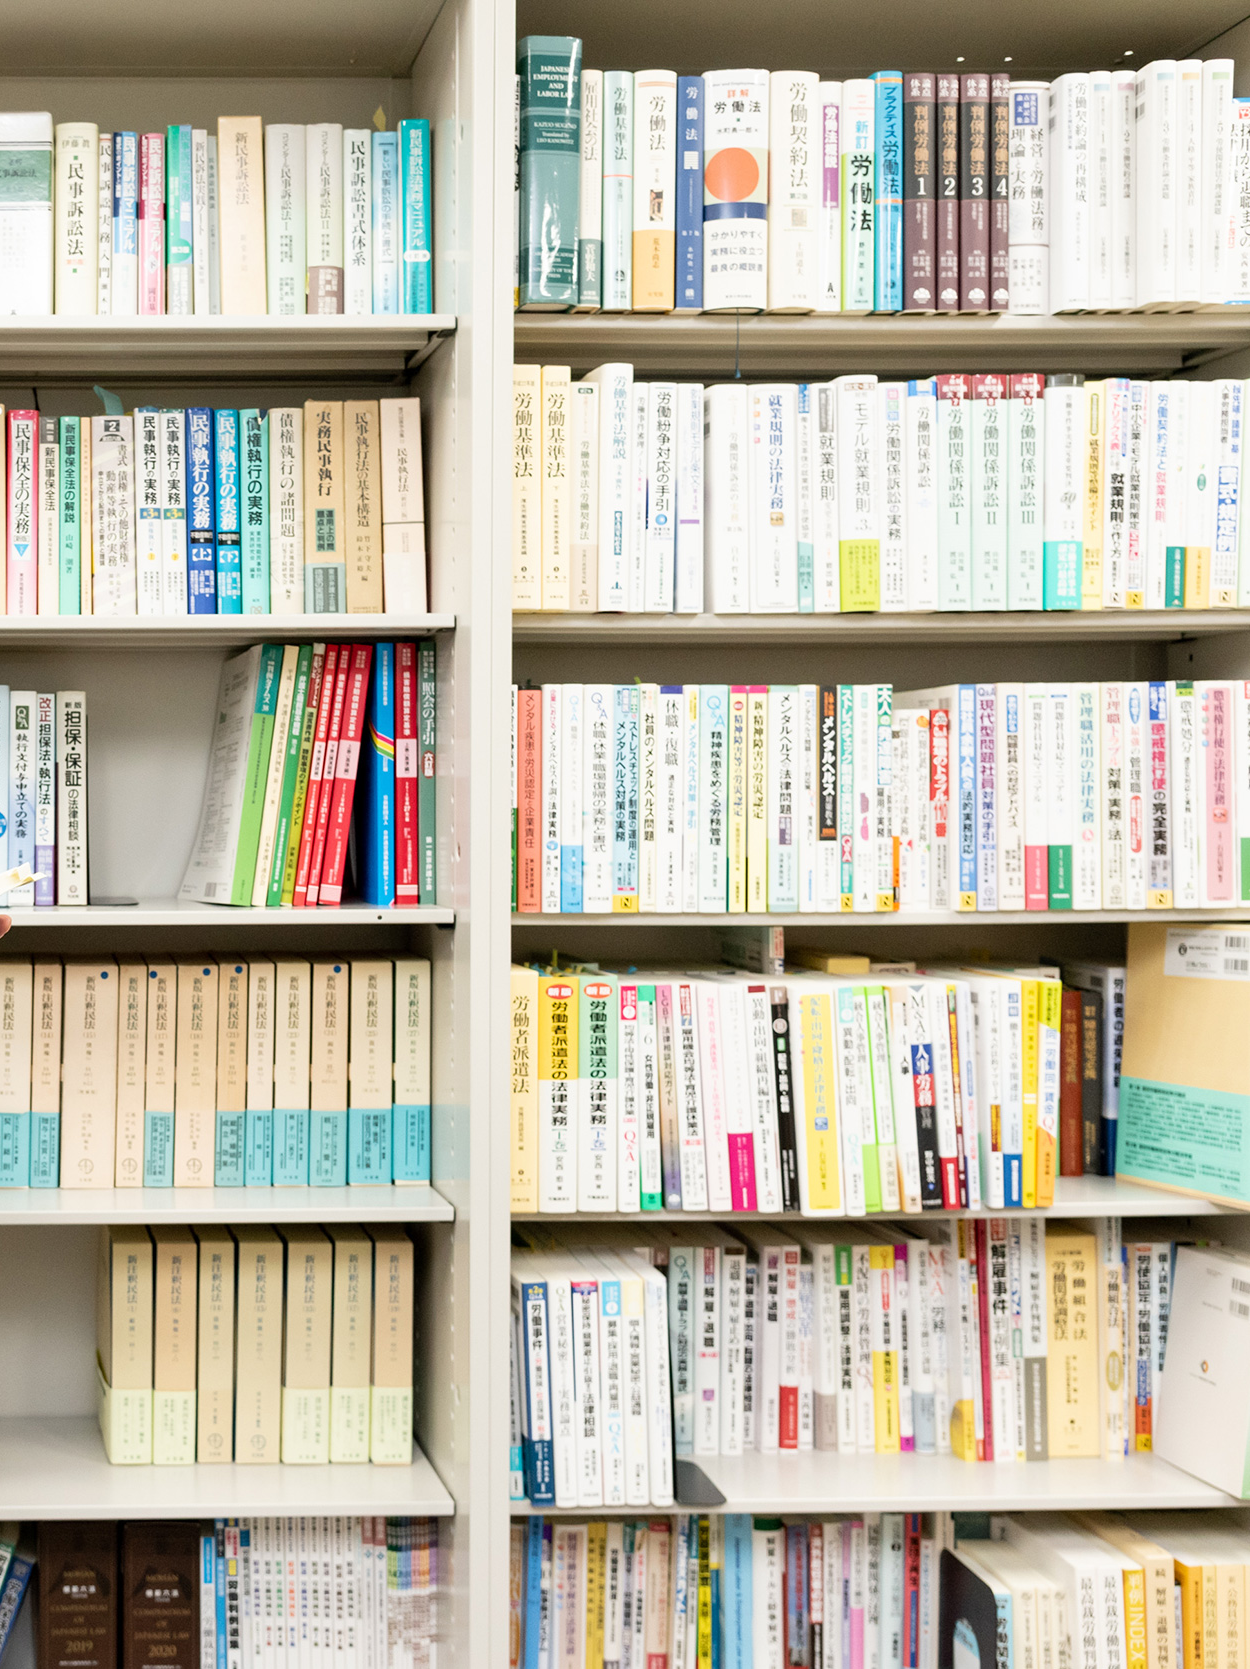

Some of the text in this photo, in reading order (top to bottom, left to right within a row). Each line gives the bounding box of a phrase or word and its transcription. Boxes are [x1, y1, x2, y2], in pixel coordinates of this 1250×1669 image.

[614, 86, 628, 161] 労働基準法
[650, 95, 667, 151] 労働法
[685, 86, 700, 148] 労働法
[714, 101, 762, 114] 労働法
[726, 89, 750, 99] 詳解
[855, 120, 869, 150] 新訂
[235, 131, 250, 206] 新民事訴訟法
[790, 82, 809, 195] 労働契約法
[882, 86, 900, 195] プラクティス労働法
[913, 105, 930, 176] 判例労働法
[941, 105, 957, 176] 判例労働法
[969, 105, 986, 176] 判例労働法
[994, 105, 1010, 176] 判例労働法
[1010, 128, 1026, 201] 理論と実務
[67, 162, 85, 257] 民事訴訟法
[350, 141, 366, 267] 民事訴訟書式体系
[850, 154, 872, 232] 労働法
[918, 178, 928, 196] 1
[944, 178, 956, 196] 2
[971, 178, 984, 196] 3
[996, 178, 1008, 197] 4
[710, 230, 763, 241] 分かりやすく
[710, 247, 764, 258] 実務に役立つ
[710, 264, 764, 275] 最良の概説書
[14, 422, 30, 533] 民事保全の実務
[44, 446, 56, 512] 新民事保全法
[64, 424, 76, 525] 新民事保全法の解説
[143, 416, 157, 505] 民事執行の実務
[166, 418, 181, 505] 民事執行の実務
[191, 416, 210, 529] 民事執行の実務
[218, 416, 238, 530] 民事執行の実務
[246, 417, 263, 526] 債権執行の実務
[280, 414, 295, 538] 債権執行の諸問題
[316, 412, 332, 497] 実務民事執行
[355, 414, 371, 528] 民事執行法の基本構造
[514, 393, 533, 481] 労働基準法
[547, 393, 566, 480] 労働基準法
[655, 391, 671, 513] 労働紛争対応の手引
[769, 394, 784, 510] 就業規則の法律実務
[820, 434, 835, 501] 就業規則
[854, 402, 870, 514] モデル就業規則
[917, 406, 931, 489] 労働関係訴訟
[948, 408, 964, 509] 労働関係訴訟
[983, 408, 999, 508] 労働関係訴訟
[1019, 408, 1035, 507] 労働関係訴訟
[886, 422, 901, 541] 労働関係訴訟の実務
[421, 681, 436, 745] 照会の手引
[664, 699, 679, 767] 休職・復職
[778, 694, 793, 816] メンタルヘルスの法律問題
[14, 733, 28, 839] 執行文付与申立ての実務
[64, 710, 82, 841] 担保・保証の法律相談
[524, 694, 537, 848] メンタル疾患の労災認定と企業責任
[615, 721, 626, 842] メンタルヘルス対策の実務
[627, 721, 638, 860] ストレスチェック制度の運用と
[643, 713, 656, 842] 社員のメンタルヘルス問題
[709, 730, 723, 847] 精神疾患をめぐる労務管理
[513, 995, 530, 1093] 労働者派遣法
[551, 1002, 568, 1127] 労働者派遣法の法律実務
[590, 1001, 607, 1125] 労働者派遣法の法律実務
[531, 1303, 544, 1352] 労働事件
[1072, 1260, 1088, 1341] 労働組合法
